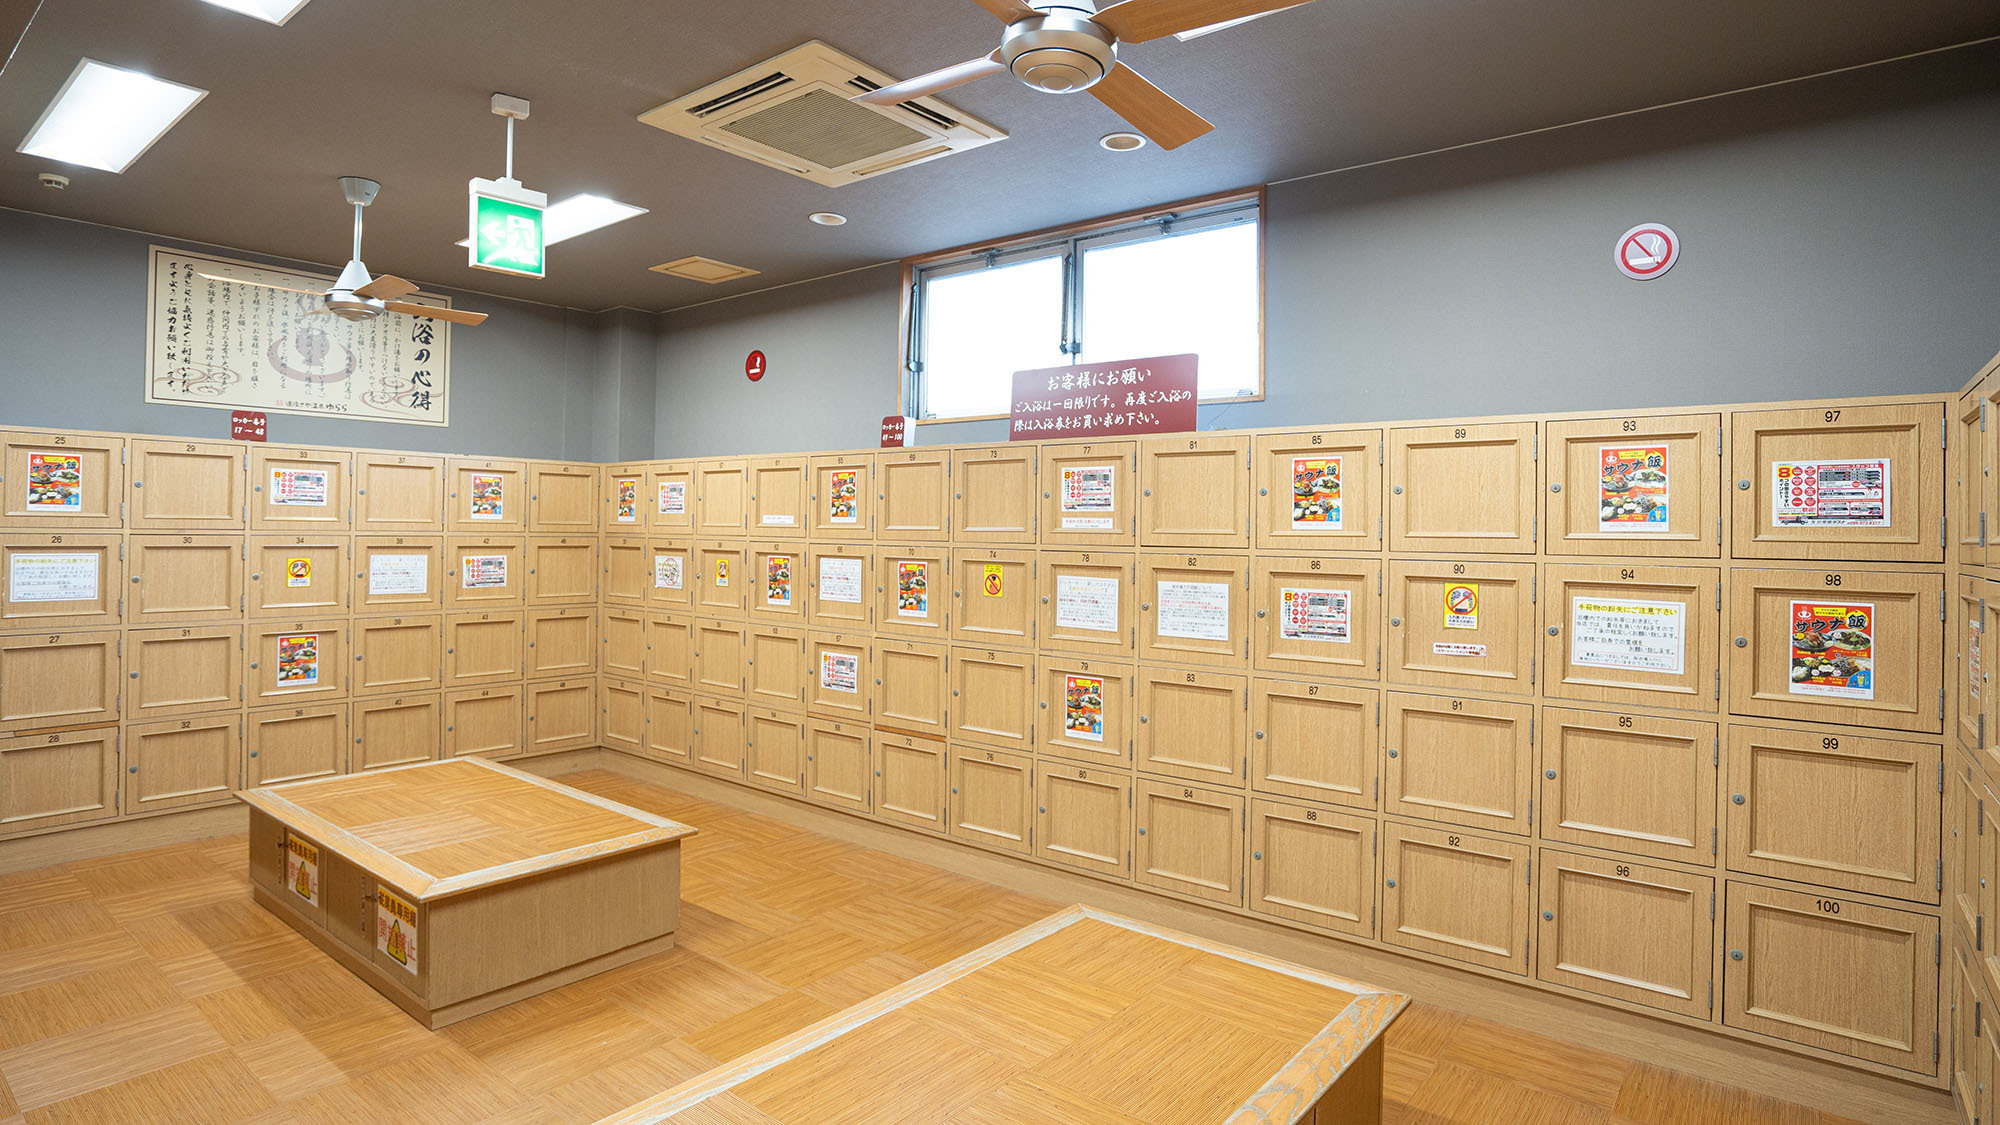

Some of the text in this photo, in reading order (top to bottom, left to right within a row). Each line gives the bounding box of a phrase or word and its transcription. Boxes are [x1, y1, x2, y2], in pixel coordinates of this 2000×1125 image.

[1047, 367, 1152, 391] お客様にお願い
[1824, 410, 1841, 423] 97
[1013, 412, 1162, 433] 際は入浴券をお買い求め下さい。
[1622, 420, 1637, 432] 93
[1454, 428, 1467, 439] 89
[54, 436, 66, 445] 25
[1189, 441, 1198, 449] 81
[1311, 435, 1322, 445] 85
[186, 444, 196, 452] 29
[1083, 446, 1092, 454] 77
[299, 451, 308, 459] 33
[990, 450, 998, 458] 73
[1603, 454, 1664, 475] サウナ飯
[1064, 471, 1071, 479] 8
[1295, 464, 1339, 482] サウナ飯
[1778, 467, 1790, 478] 8
[51, 535, 63, 544] 26
[183, 536, 193, 544] 30
[296, 536, 305, 544] 34
[908, 548, 915, 556] 70
[989, 551, 997, 559] 74
[1082, 553, 1090, 562] 78
[1187, 557, 1197, 567] 82
[1310, 560, 1321, 570] 86
[1453, 563, 1466, 575] 90
[1620, 568, 1635, 580] 94
[1825, 573, 1842, 587] 98
[1284, 592, 1292, 601] 8
[1578, 603, 1678, 617] 手荷物の紛失にご注意下さい
[295, 623, 304, 631] 35
[1795, 614, 1866, 632] サウナ飯
[182, 629, 190, 637] 31
[49, 635, 60, 644] 27
[987, 651, 995, 661] 75
[1081, 661, 1089, 671] 79
[1186, 673, 1196, 683] 83
[1308, 685, 1319, 696] 87
[1452, 700, 1463, 711] 91
[181, 720, 191, 729] 32
[1618, 716, 1633, 728] 95
[48, 734, 60, 744] 28
[905, 737, 913, 747] 72
[1822, 737, 1839, 750] 99
[986, 752, 994, 762] 76
[1078, 770, 1087, 780] 80
[1183, 788, 1193, 799] 84
[1306, 810, 1317, 821] 88
[1448, 835, 1461, 847] 92
[1616, 864, 1630, 878] 96
[1816, 899, 1840, 914] 100
